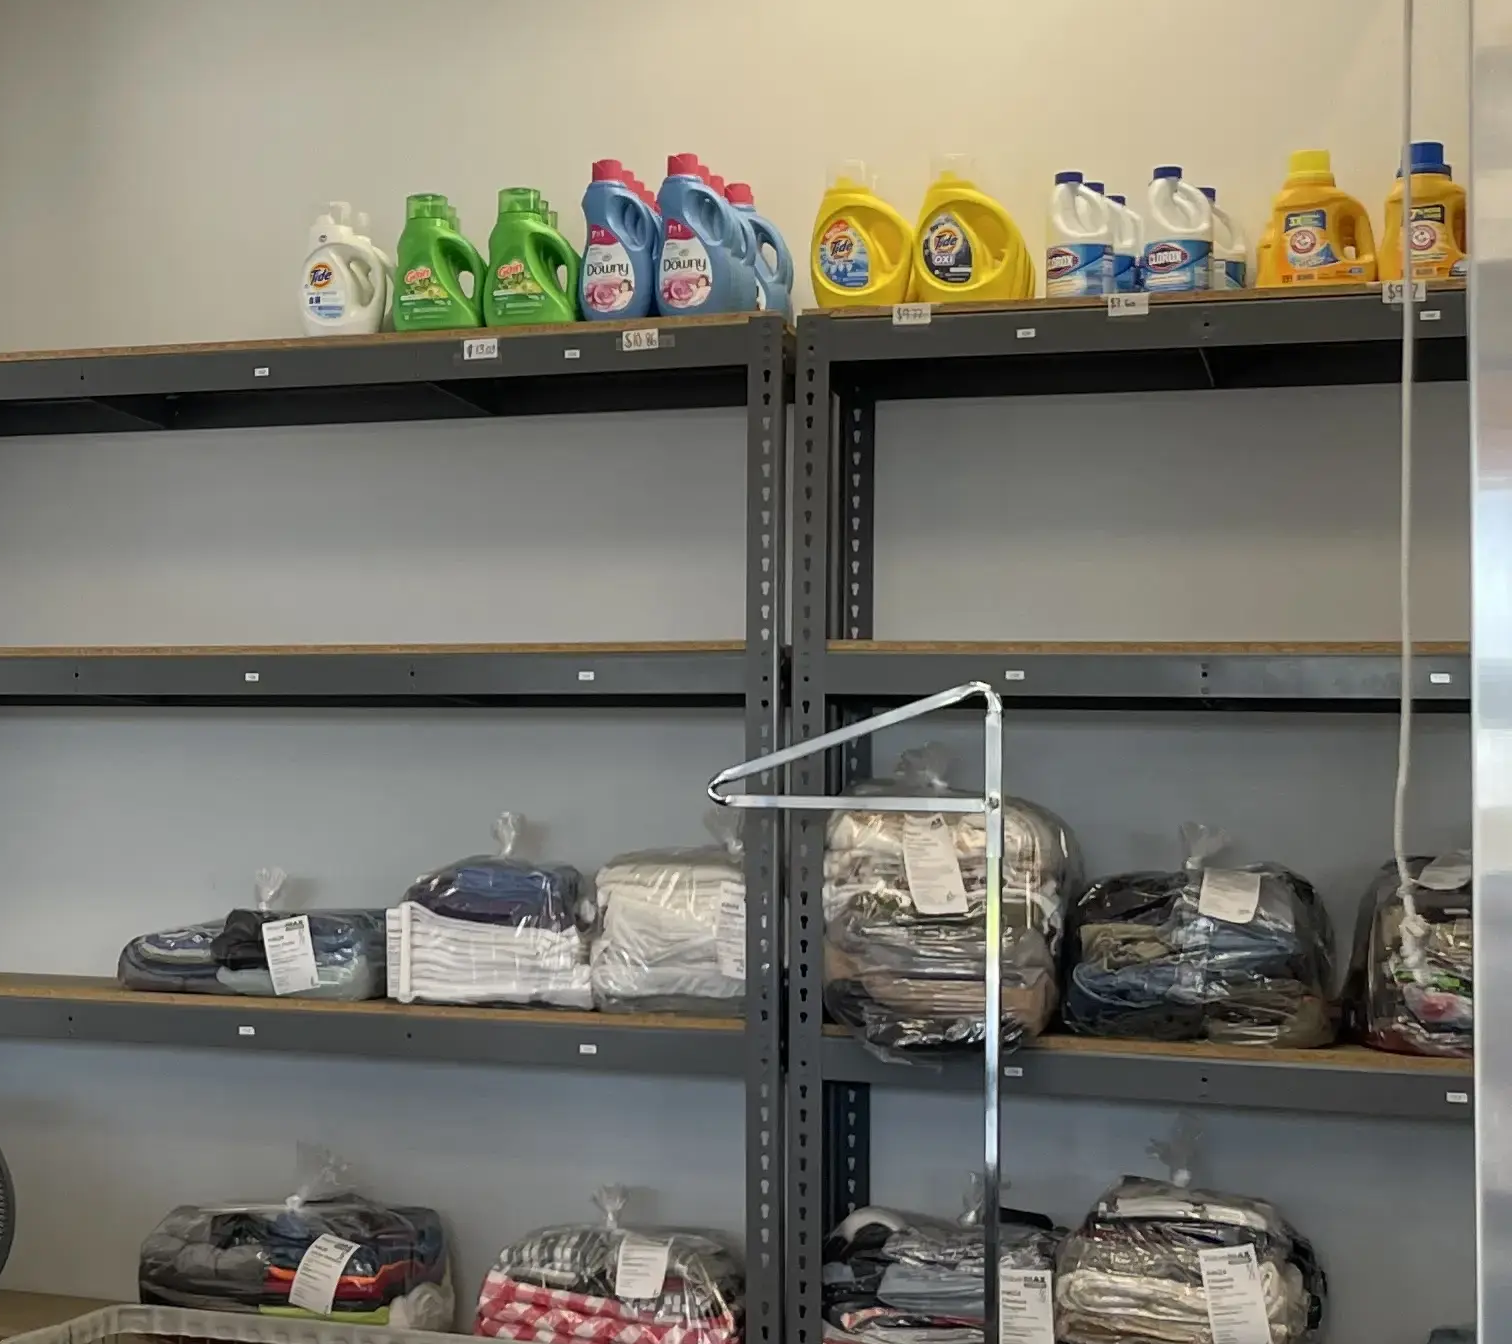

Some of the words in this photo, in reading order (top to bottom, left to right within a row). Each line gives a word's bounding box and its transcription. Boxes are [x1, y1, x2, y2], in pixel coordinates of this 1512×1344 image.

[830, 239, 854, 256] Tide
[935, 233, 958, 250] Tide
[663, 257, 706, 273] Downy
[1148, 250, 1182, 266] CLOROX
[310, 268, 332, 287] Tide
[586, 262, 629, 277] Downy
